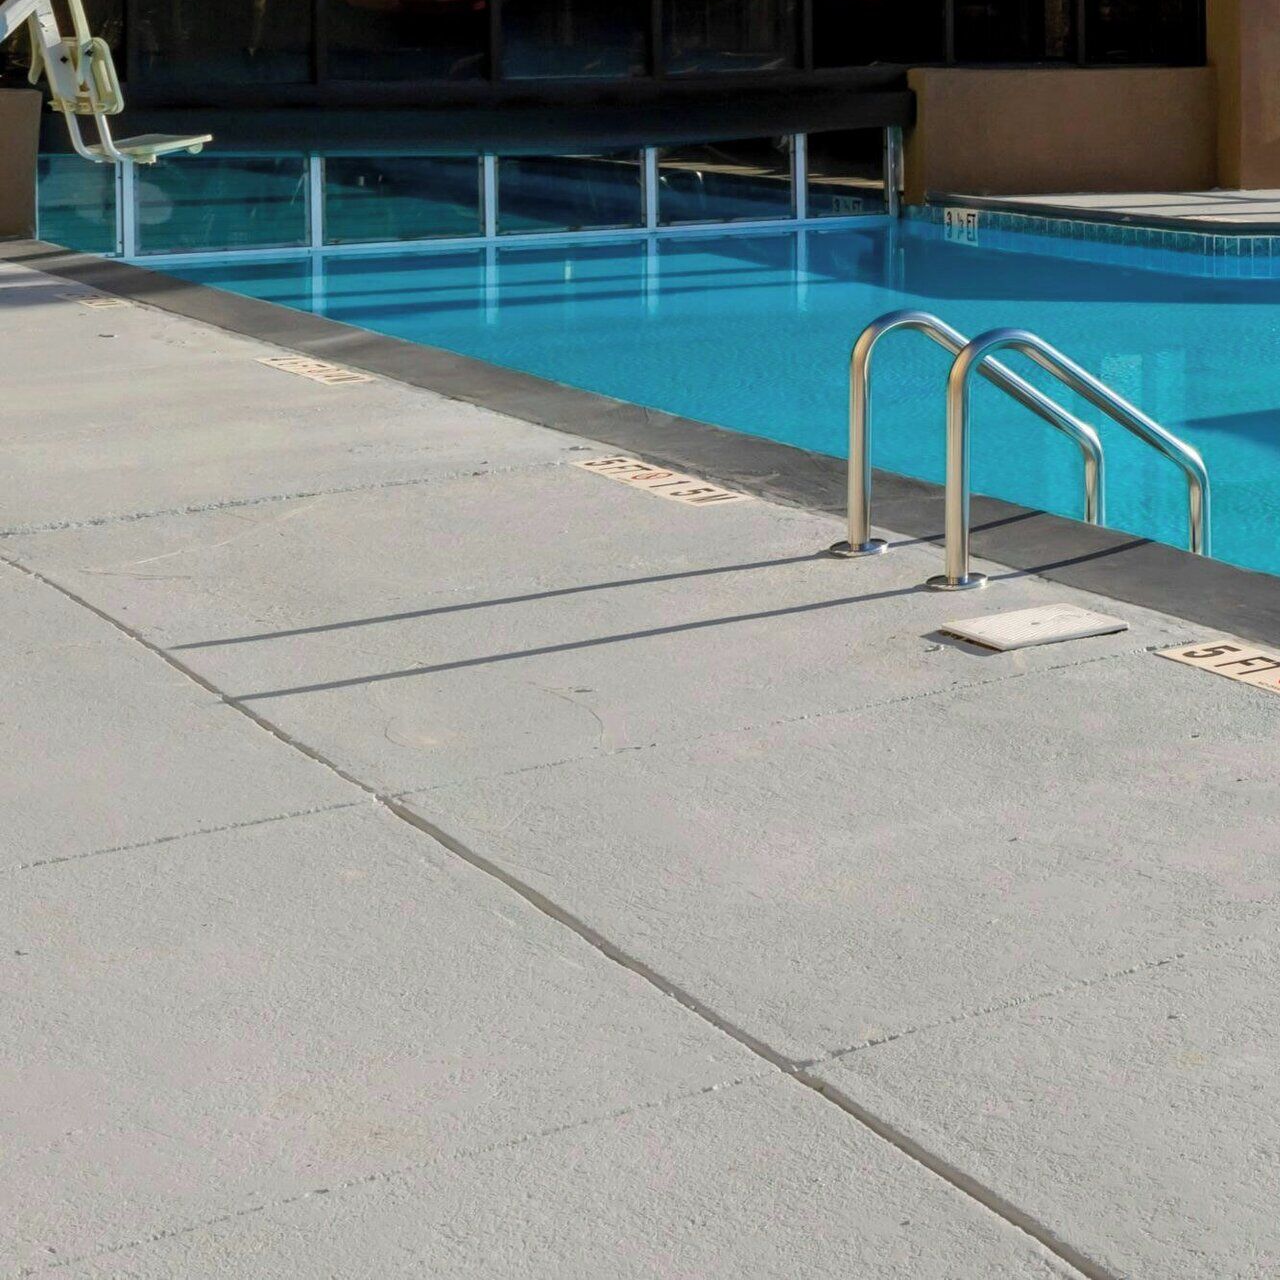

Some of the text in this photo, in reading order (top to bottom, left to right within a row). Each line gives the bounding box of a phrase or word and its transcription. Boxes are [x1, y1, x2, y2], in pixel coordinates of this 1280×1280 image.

[966, 213, 977, 228] FT
[584, 458, 628, 467] 5
[598, 464, 653, 475] FT
[1182, 645, 1241, 658] 5
